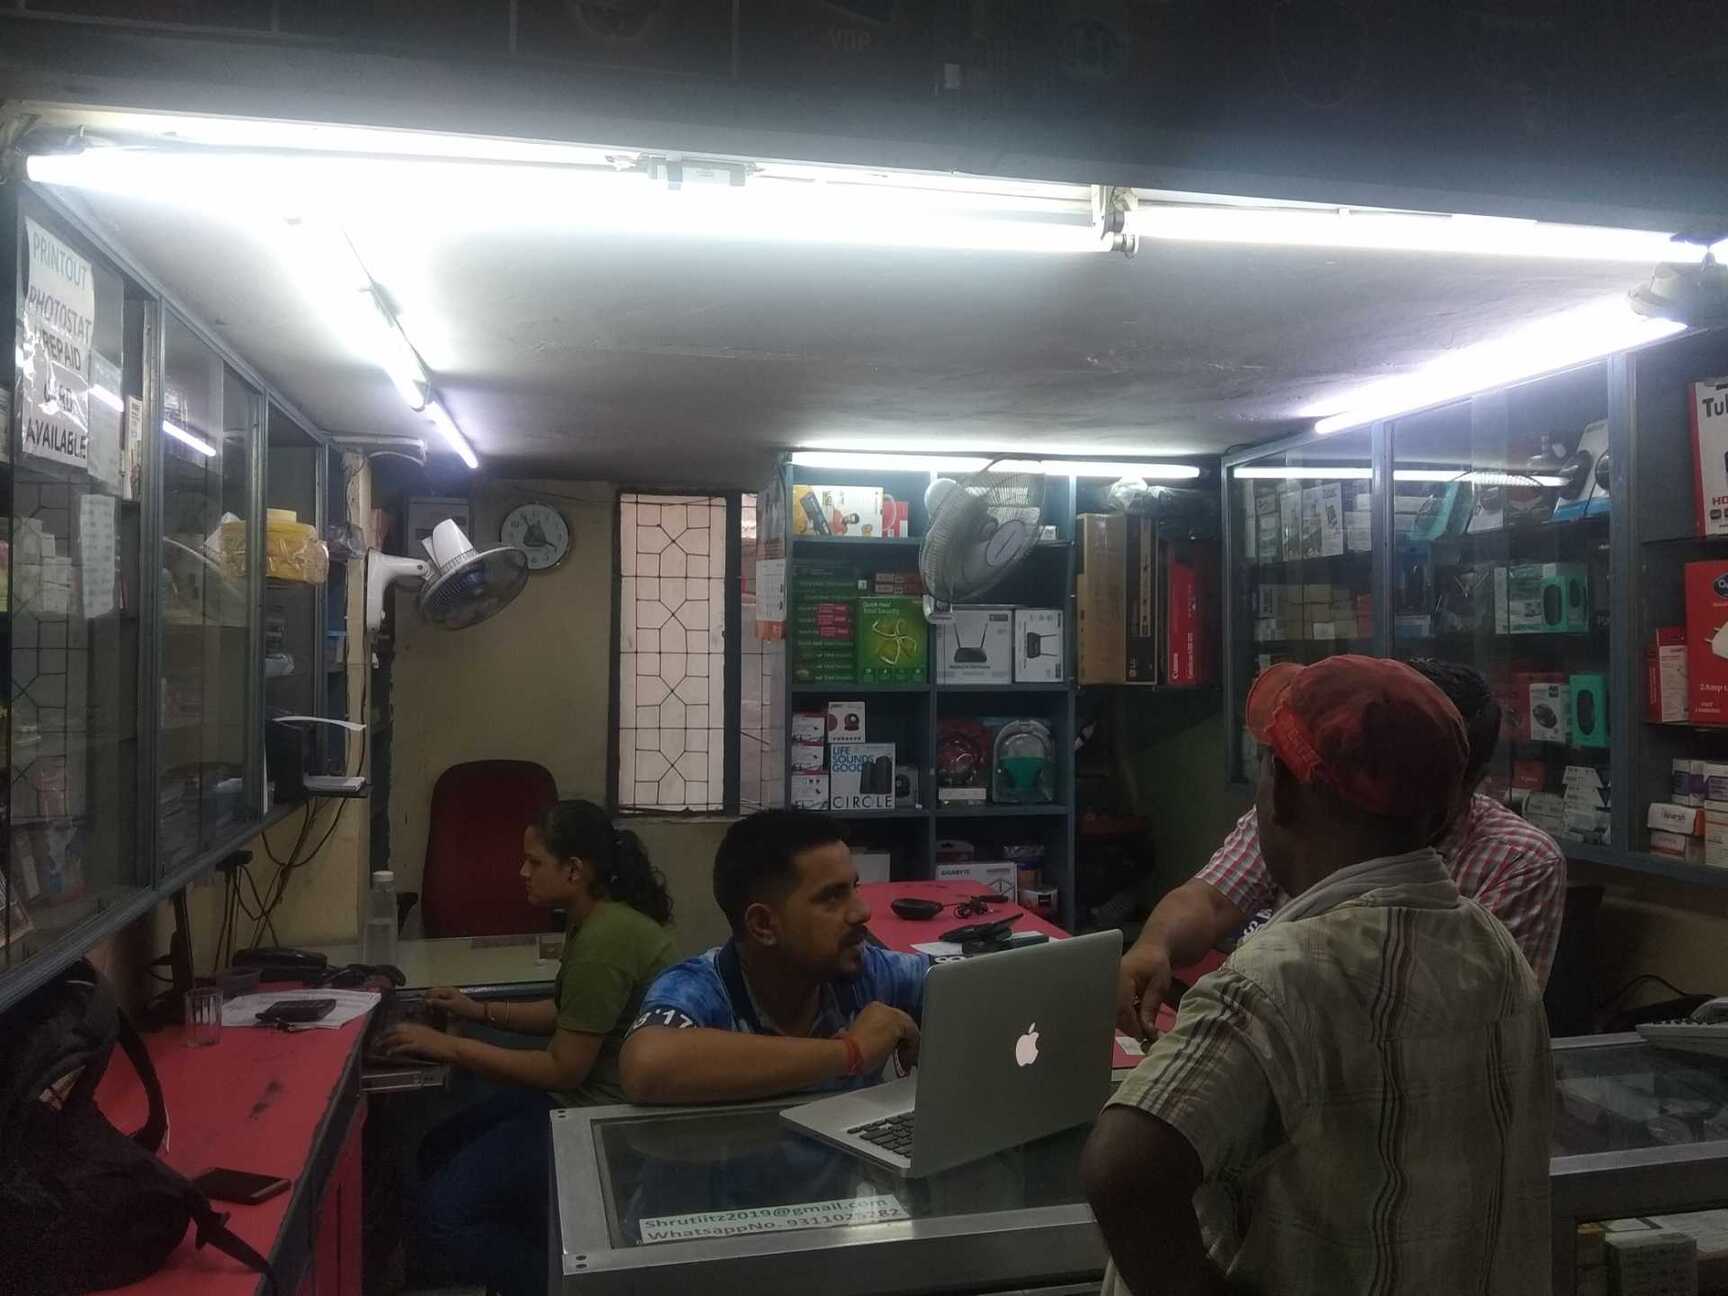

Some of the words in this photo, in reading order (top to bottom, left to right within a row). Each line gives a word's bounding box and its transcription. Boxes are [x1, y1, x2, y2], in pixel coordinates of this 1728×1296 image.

[33, 232, 87, 289] PRINTOUT
[29, 285, 93, 345] PHOTOSTAT
[35, 327, 81, 371] REPAID
[26, 416, 87, 460] AVAILABLE
[832, 746, 849, 756] LIFE
[832, 755, 874, 765] SOUNDS
[832, 763, 864, 773] GOOD
[832, 796, 893, 809] CIRCLE
